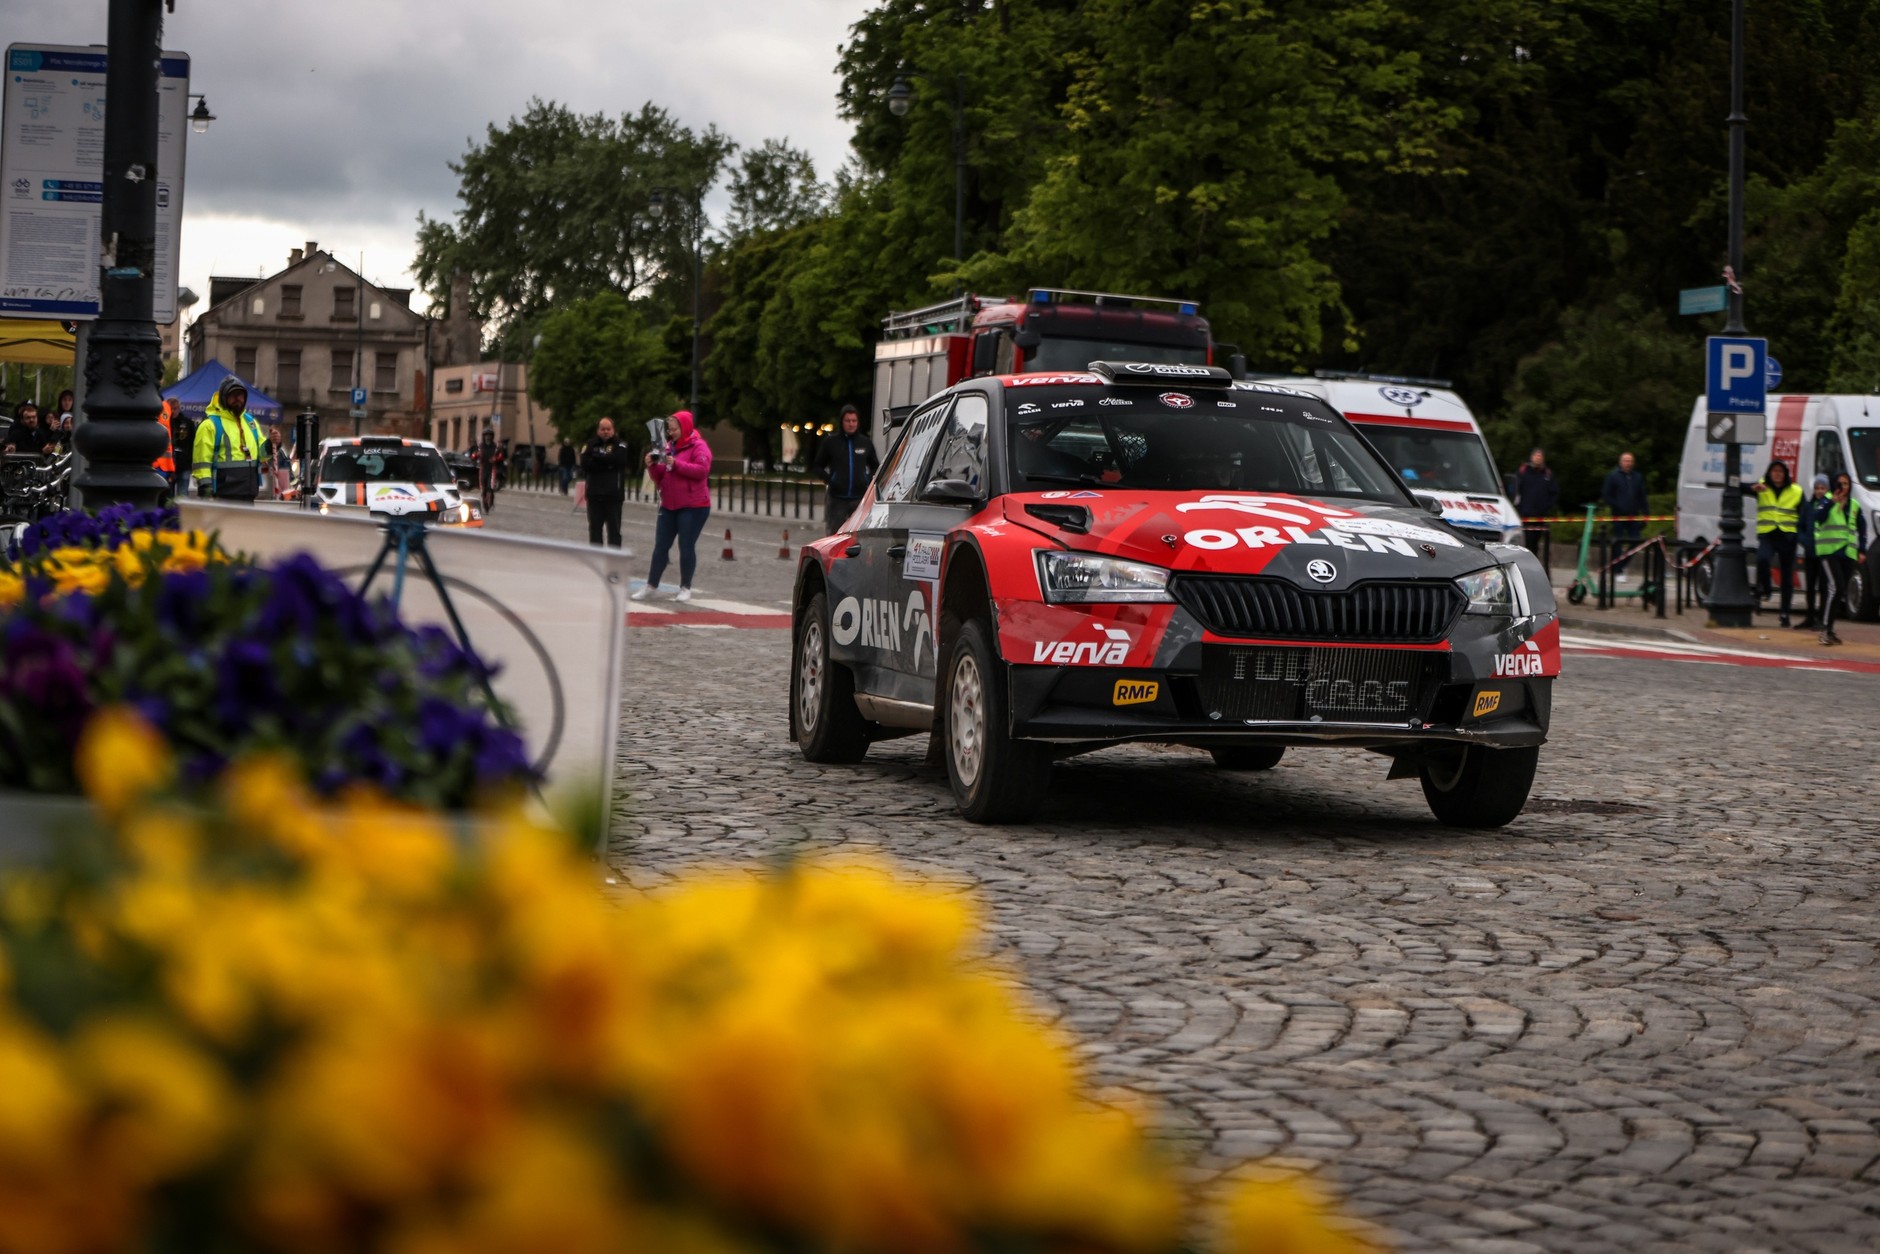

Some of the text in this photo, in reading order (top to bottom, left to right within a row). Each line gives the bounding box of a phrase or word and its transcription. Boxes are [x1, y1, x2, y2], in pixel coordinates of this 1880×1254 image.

[1722, 344, 1755, 390] P
[1012, 377, 1099, 386] verva
[1051, 400, 1084, 408] verva
[1183, 525, 1416, 558] ORLEN
[832, 596, 900, 652] ORLEN
[1033, 640, 1130, 665] verva
[1494, 653, 1543, 676] verva
[1117, 685, 1155, 700] RMF
[1305, 679, 1409, 711] CARS
[1477, 695, 1499, 712] RMF
